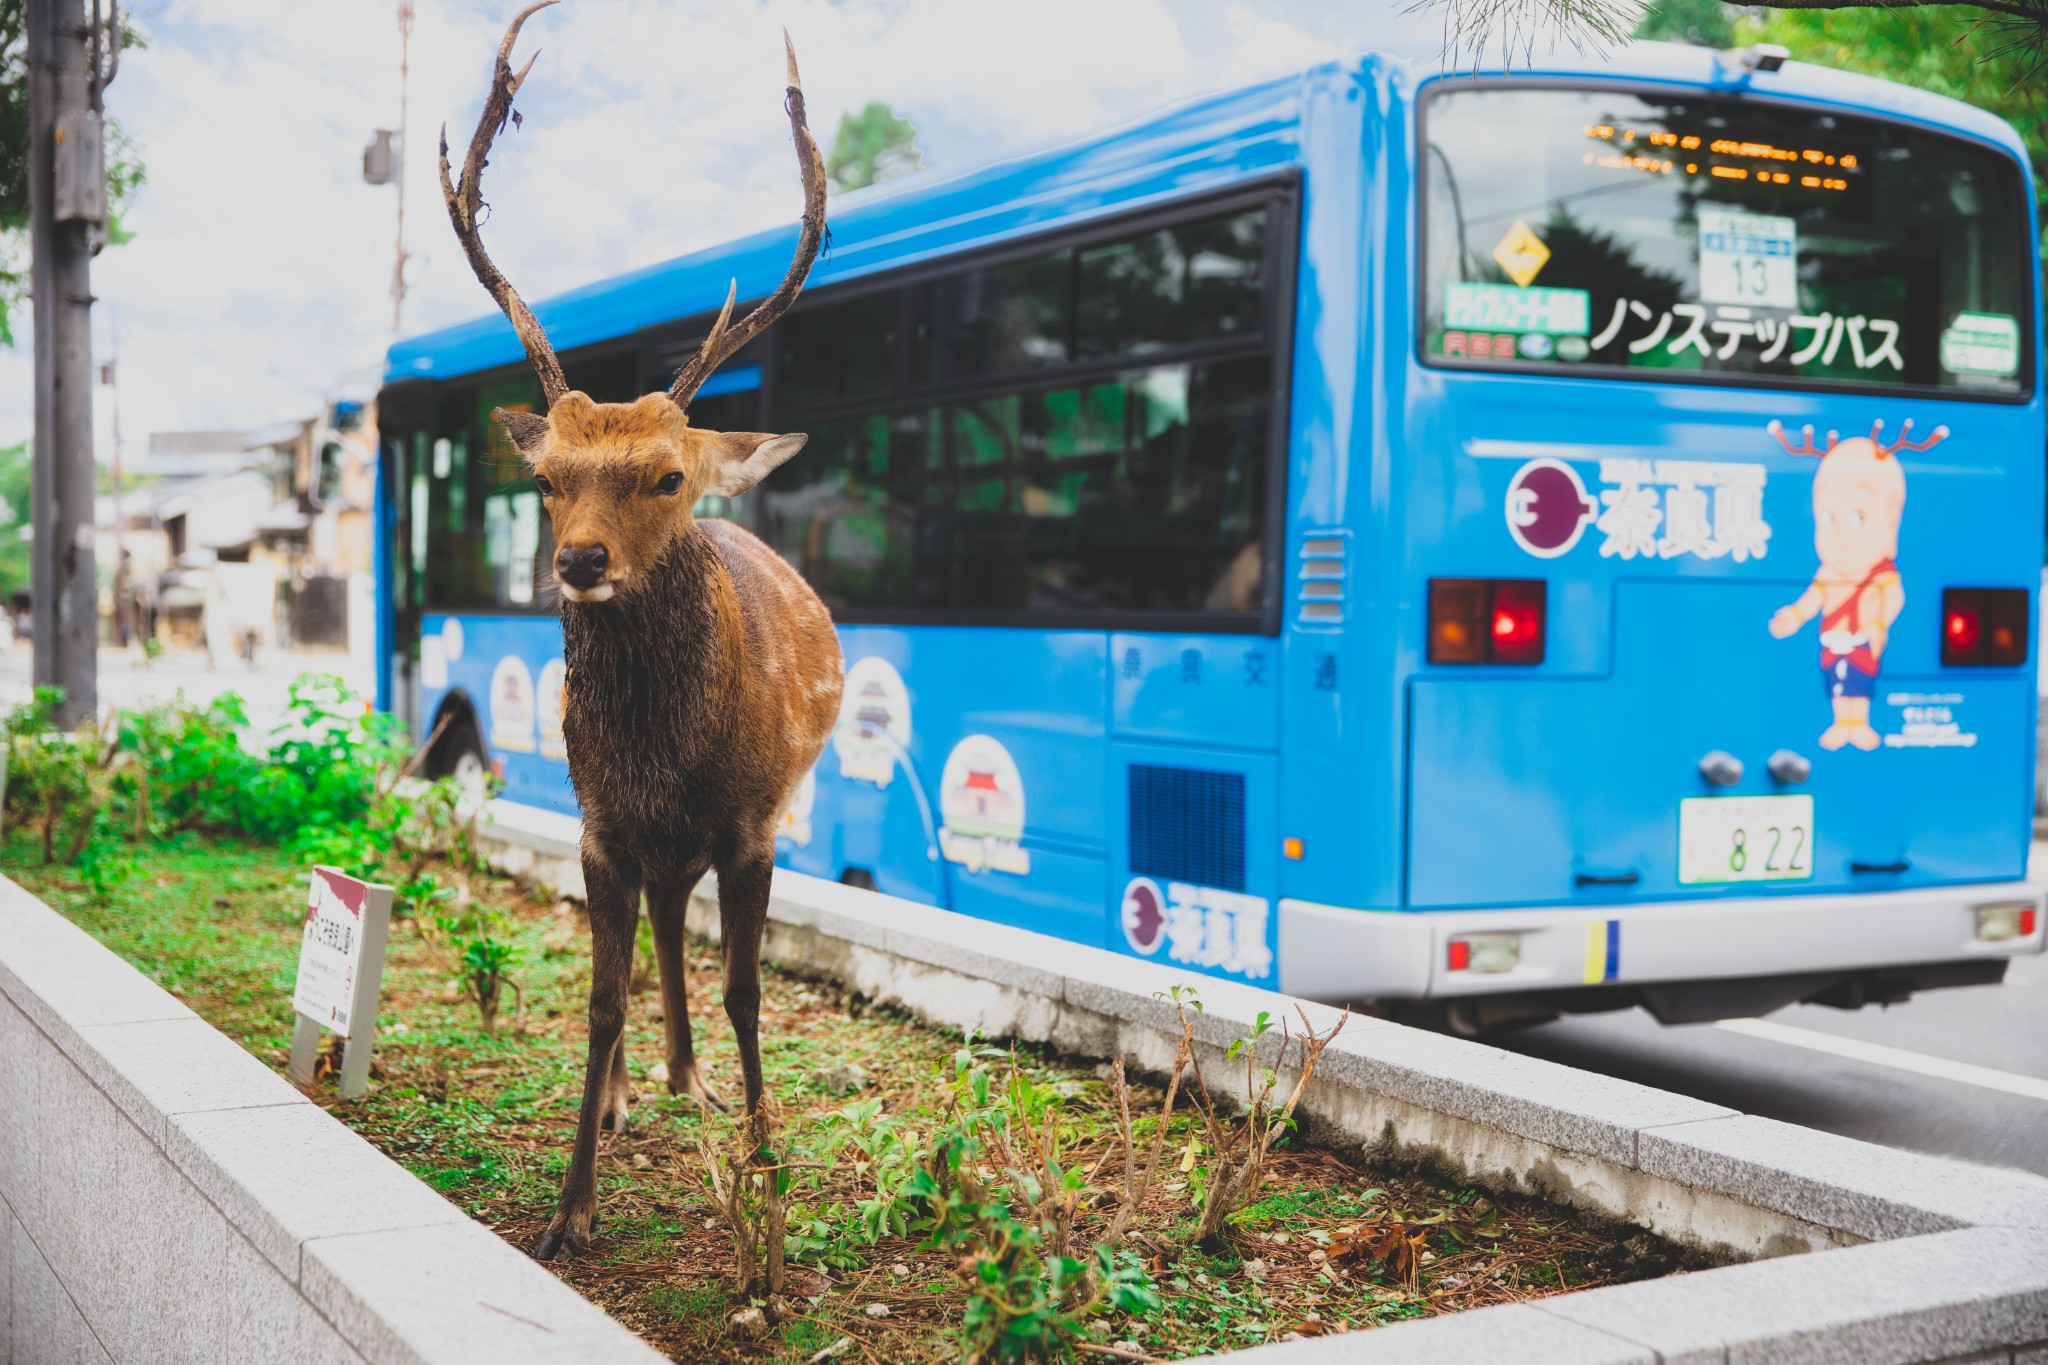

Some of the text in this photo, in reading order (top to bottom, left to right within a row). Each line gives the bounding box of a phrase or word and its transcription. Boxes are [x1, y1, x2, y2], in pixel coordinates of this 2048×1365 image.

[1733, 260, 1767, 295] 13
[1444, 331, 1516, 359] ABS
[1590, 298, 1904, 371] ノンステップバス
[1597, 479, 1772, 563] 奈良県
